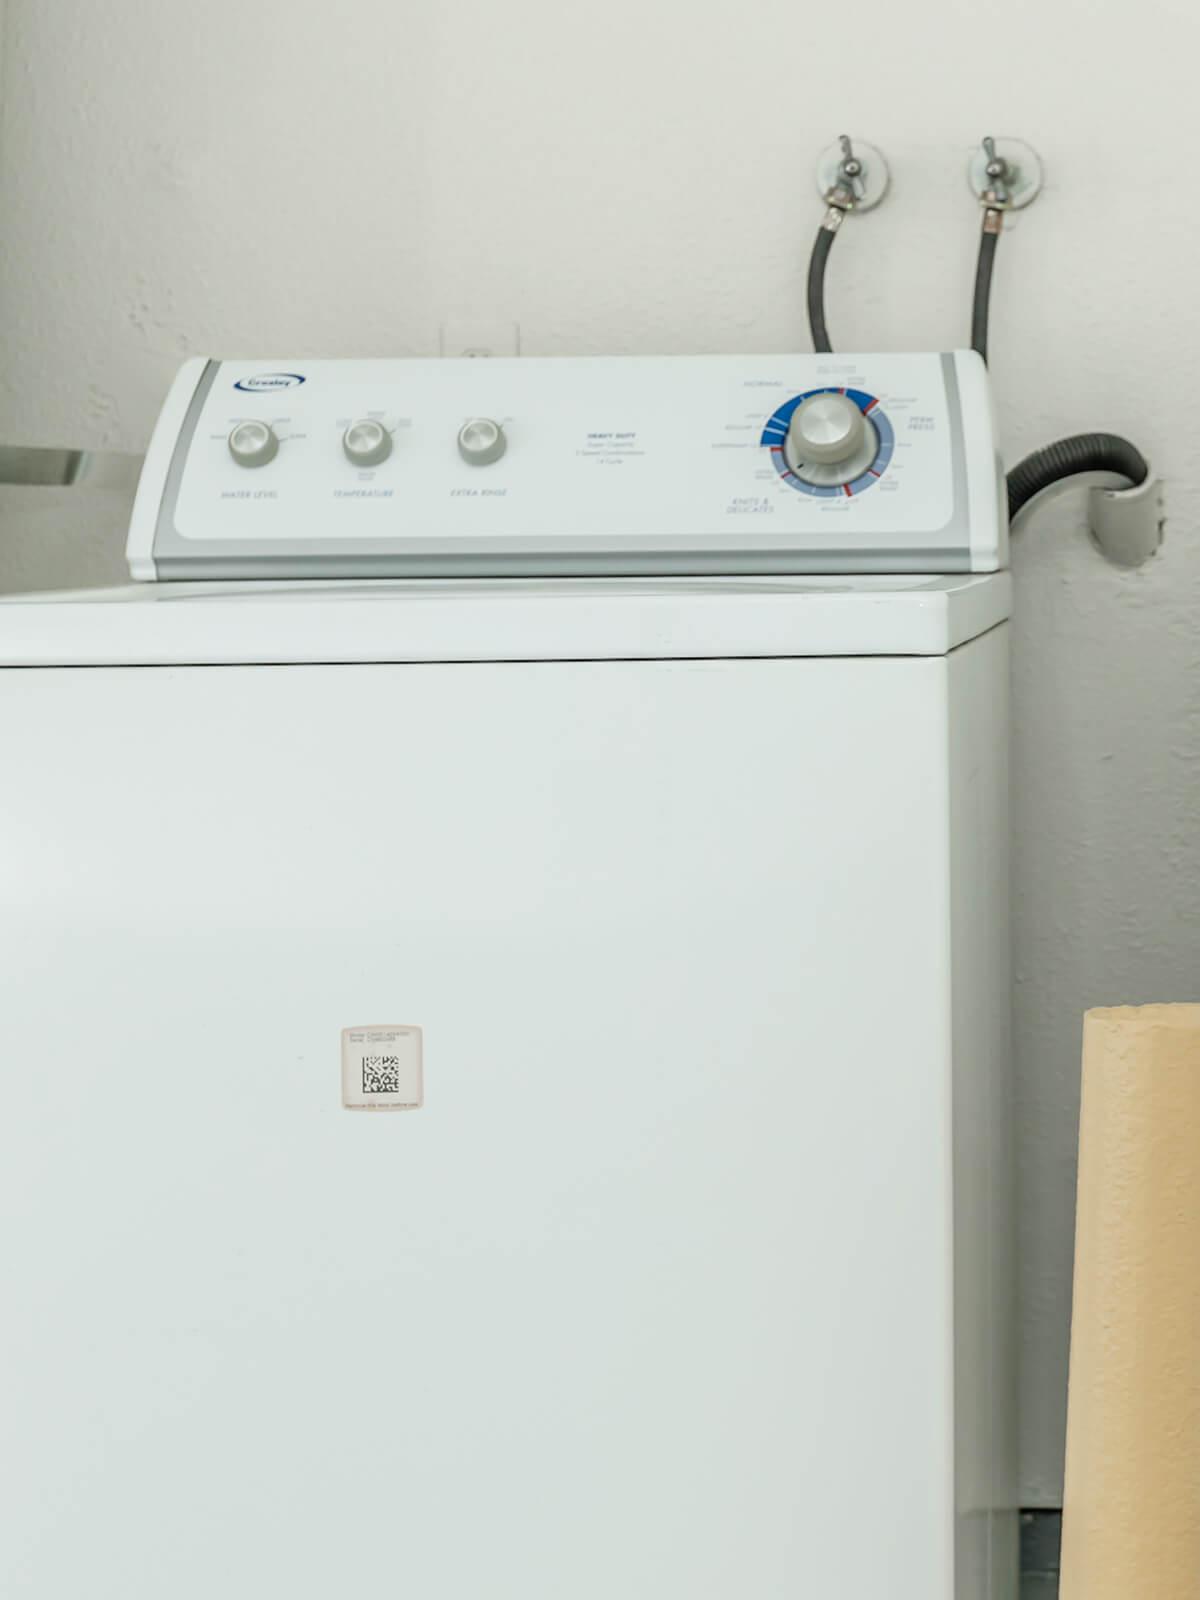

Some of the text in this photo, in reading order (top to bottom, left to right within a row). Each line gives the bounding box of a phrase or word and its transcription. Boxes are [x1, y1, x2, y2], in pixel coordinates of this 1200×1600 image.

[247, 376, 290, 387] Crosley
[586, 431, 637, 440] HEAVY DUTY
[220, 490, 279, 499] WATER LEVEL
[333, 488, 394, 498] TEMPERATURE
[450, 488, 508, 497] EXTRA RINSE
[731, 497, 761, 505] KNITS
[725, 505, 775, 514] DELICATES
